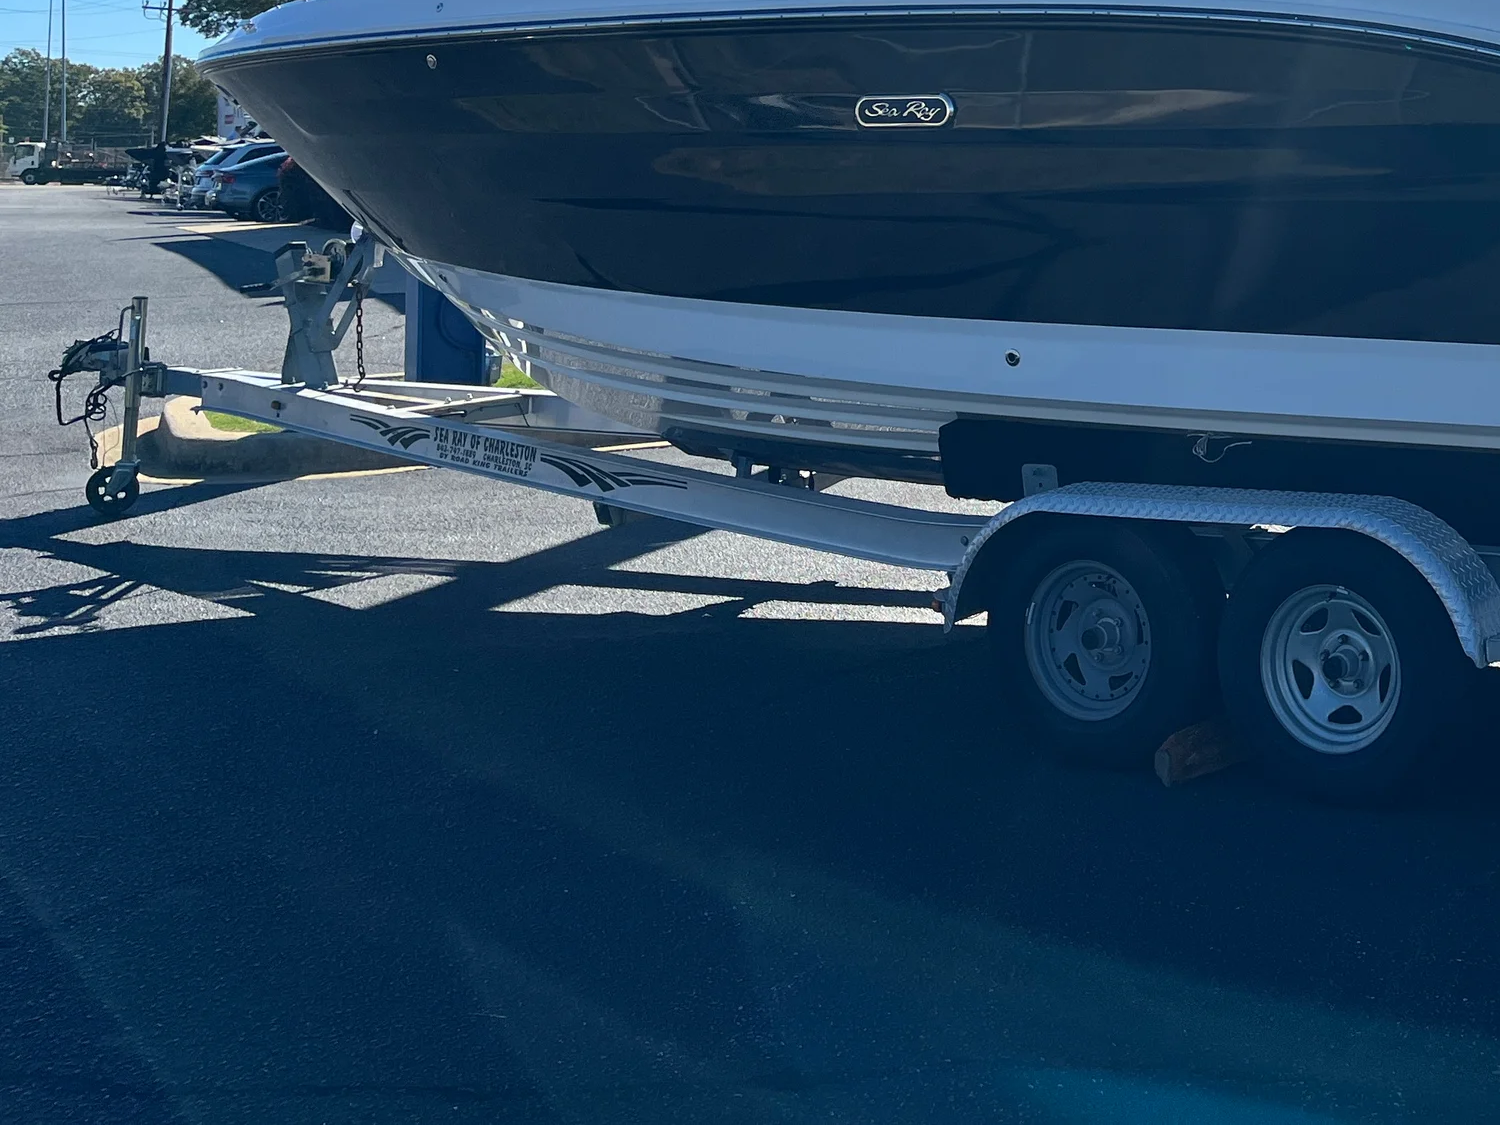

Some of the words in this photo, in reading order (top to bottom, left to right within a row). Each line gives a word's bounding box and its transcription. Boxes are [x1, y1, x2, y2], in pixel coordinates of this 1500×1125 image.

[864, 102, 901, 117] Sea
[903, 100, 941, 121] Ray
[433, 427, 449, 444] SEA
[452, 430, 468, 447] RAY
[470, 434, 481, 450] OF
[483, 437, 538, 462] CHARLESTON
[439, 452, 448, 460] BY
[450, 454, 470, 464] ROAD
[472, 460, 491, 469] KING
[493, 464, 529, 477] TRAILERS
[524, 462, 532, 471] SC
